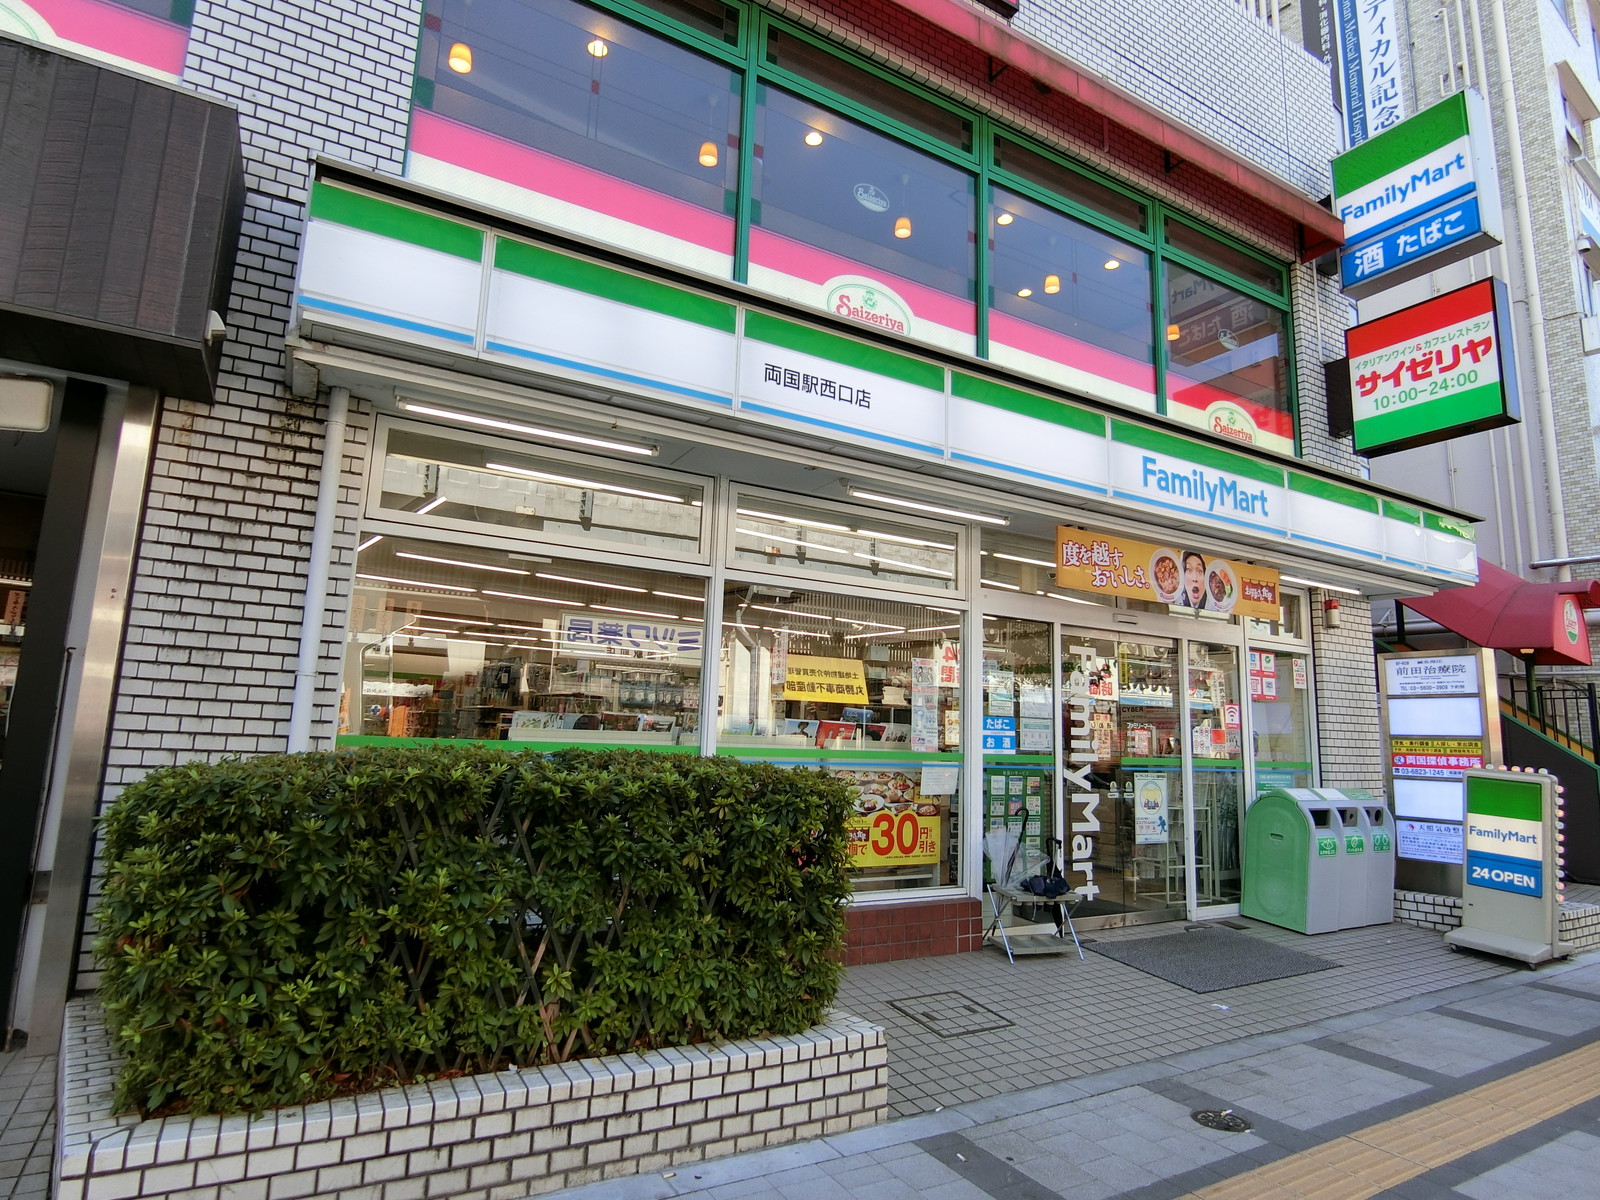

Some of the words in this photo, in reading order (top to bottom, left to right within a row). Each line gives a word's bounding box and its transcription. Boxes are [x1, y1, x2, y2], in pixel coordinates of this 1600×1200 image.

[1345, 18, 1359, 64] Medical
[1348, 57, 1363, 109] Memorial
[1340, 152, 1466, 224] FamilyMart
[1354, 241, 1385, 278] 酒
[1396, 210, 1465, 257] たばこ
[835, 294, 905, 332] Saizeriya
[764, 363, 871, 409] 両国駅西口店
[1355, 336, 1493, 398] サイゼリヤ
[1213, 416, 1253, 443] Saizeriya
[1142, 455, 1269, 517] FamilyMart
[1061, 540, 1124, 570] 度を越す
[1396, 664, 1467, 675] 前田治療院
[986, 718, 1010, 729] たばこ
[1064, 645, 1100, 900] FamilyMart
[1406, 755, 1482, 767] 両国探偵事務所
[871, 813, 919, 856] 30
[919, 826, 929, 840] 円
[919, 840, 937, 853] 引き
[1469, 825, 1537, 845] FamilyMart
[1471, 866, 1490, 879] 24
[1490, 869, 1535, 888] OPEN
